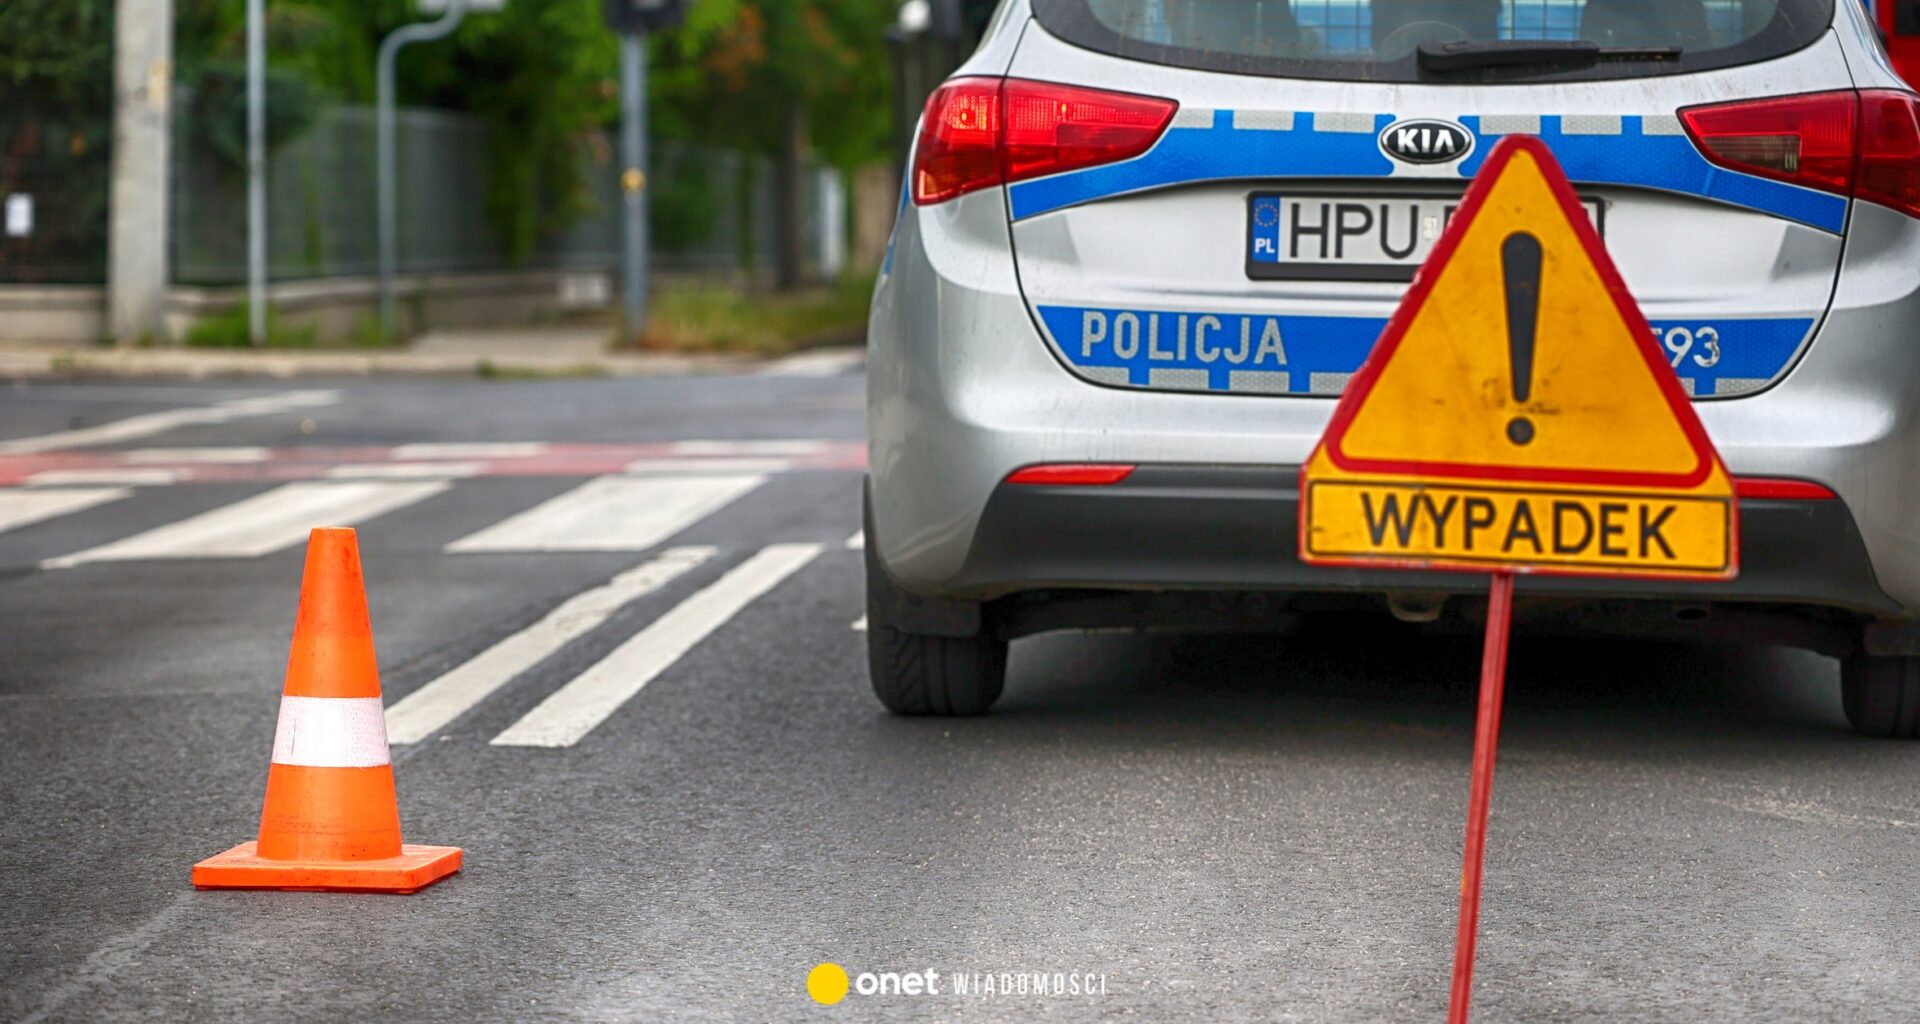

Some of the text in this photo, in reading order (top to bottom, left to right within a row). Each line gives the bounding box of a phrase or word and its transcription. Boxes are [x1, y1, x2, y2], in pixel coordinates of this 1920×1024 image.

[1397, 128, 1455, 153] KIA
[1254, 238, 1276, 254] PL
[1290, 202, 1418, 258] HPU
[1082, 310, 1287, 366] POLICJA
[1650, 326, 1720, 368] 93
[1360, 492, 1678, 560] WYPADEK
